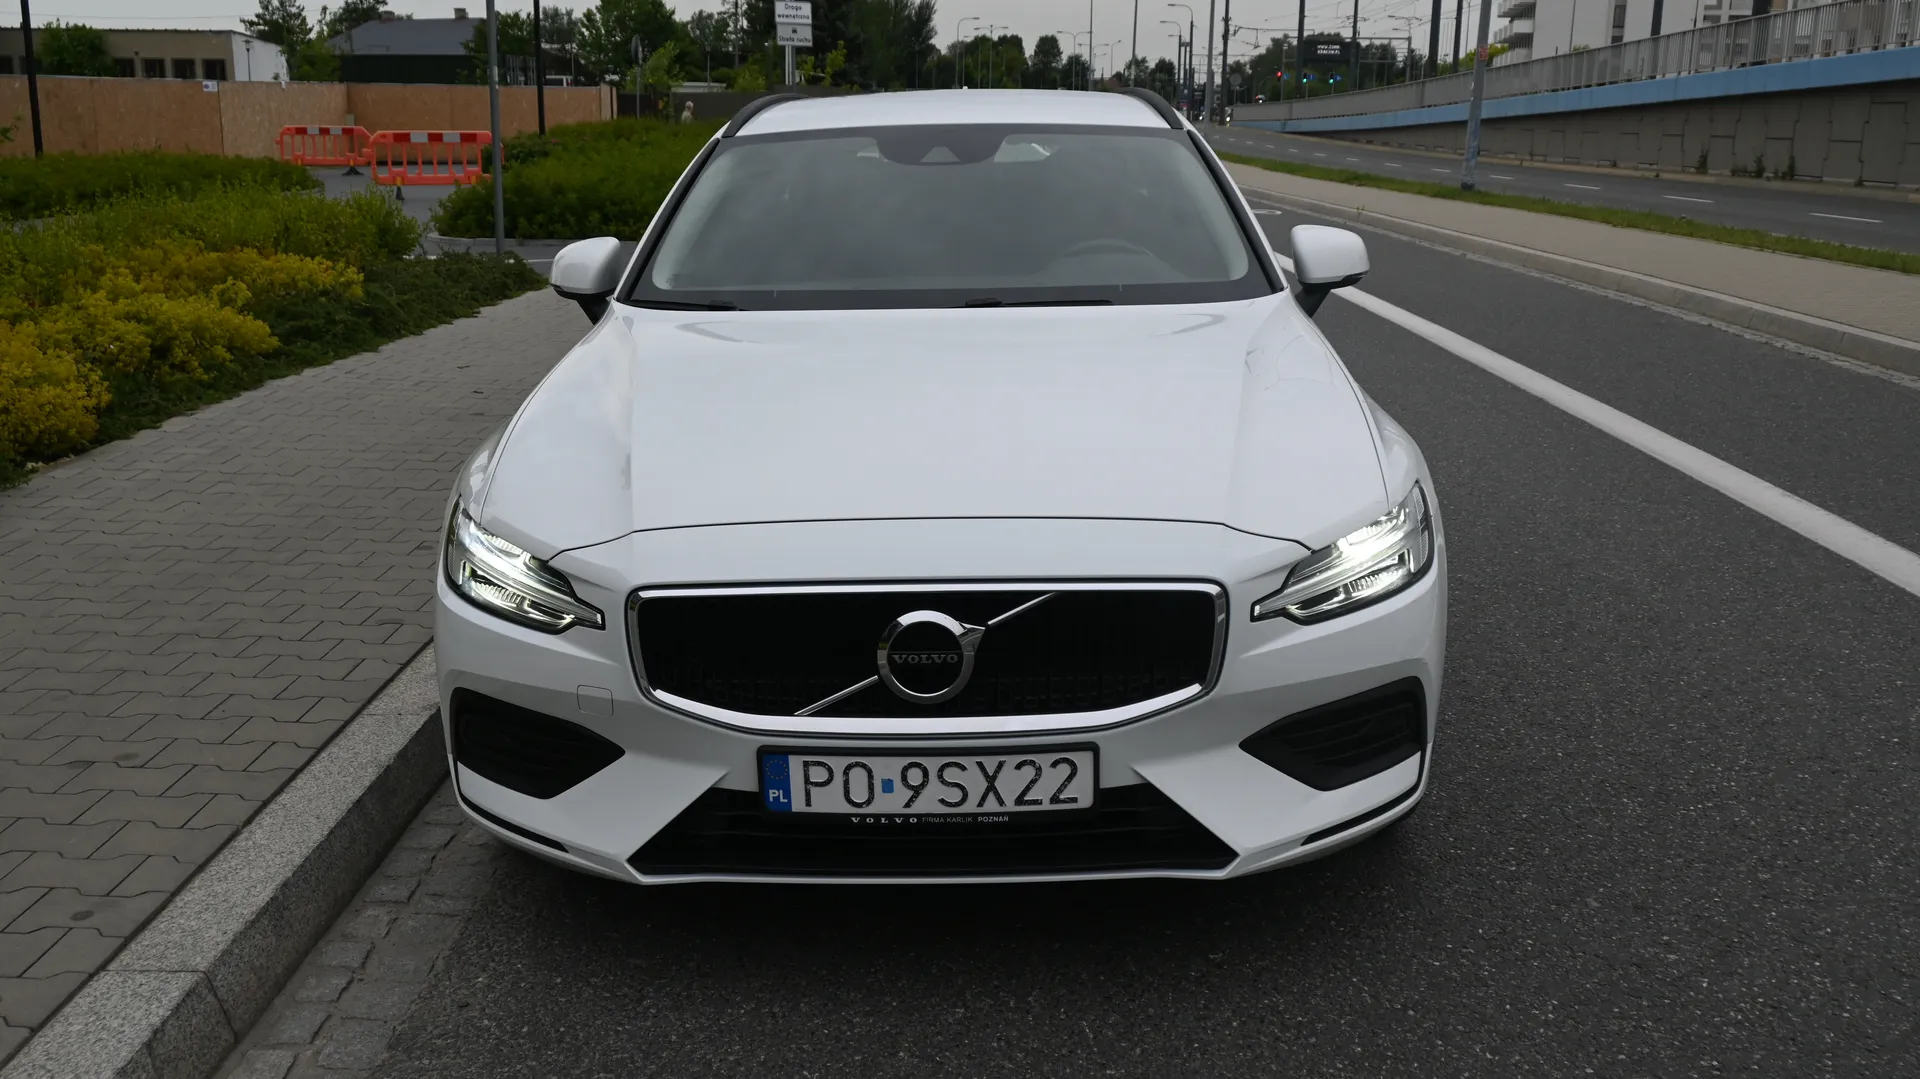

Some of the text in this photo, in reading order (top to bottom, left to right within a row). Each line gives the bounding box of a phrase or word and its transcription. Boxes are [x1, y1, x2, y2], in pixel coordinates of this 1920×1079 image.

[784, 3, 802, 11] Droga
[891, 654, 958, 664] VOLVO
[802, 757, 1079, 809] PO 9SX22
[769, 789, 788, 802] PL
